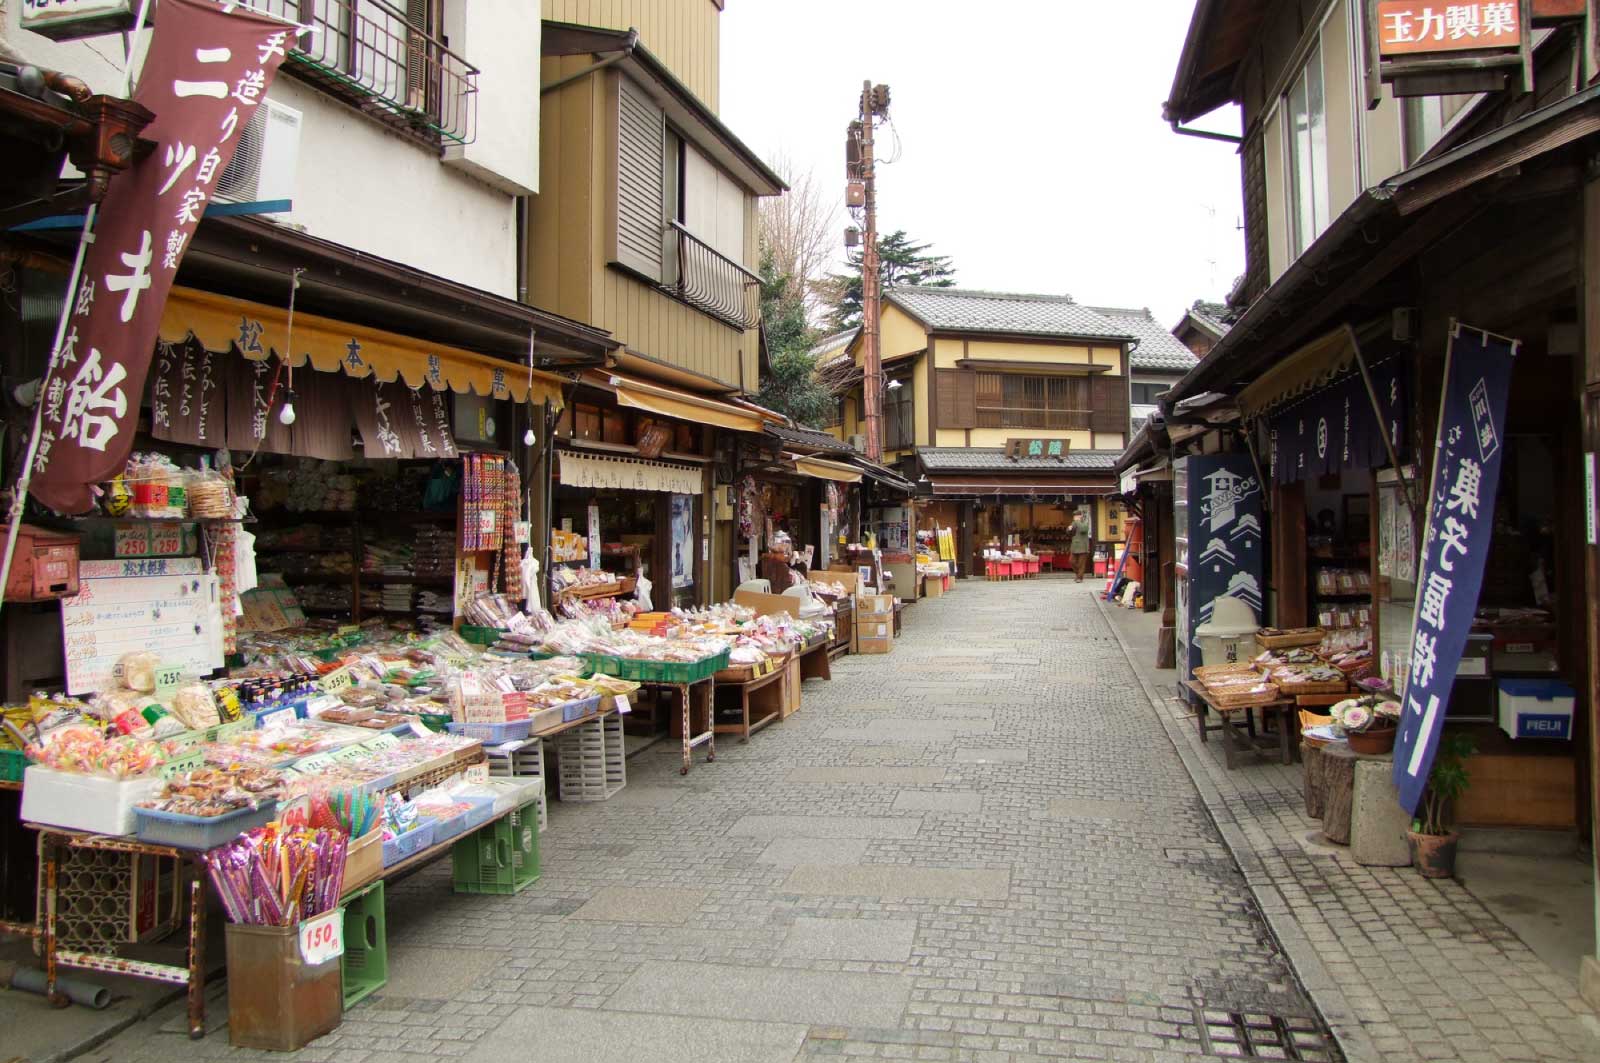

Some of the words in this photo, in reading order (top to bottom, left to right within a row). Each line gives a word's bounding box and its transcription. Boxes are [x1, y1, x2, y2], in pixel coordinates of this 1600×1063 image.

[1383, 3, 1516, 43] 玉力製菓
[163, 31, 287, 269] 手造り自家製
[33, 274, 95, 473] 松本製菓
[1200, 476, 1256, 515] KAWAGOE
[1526, 719, 1562, 731] MEIJI
